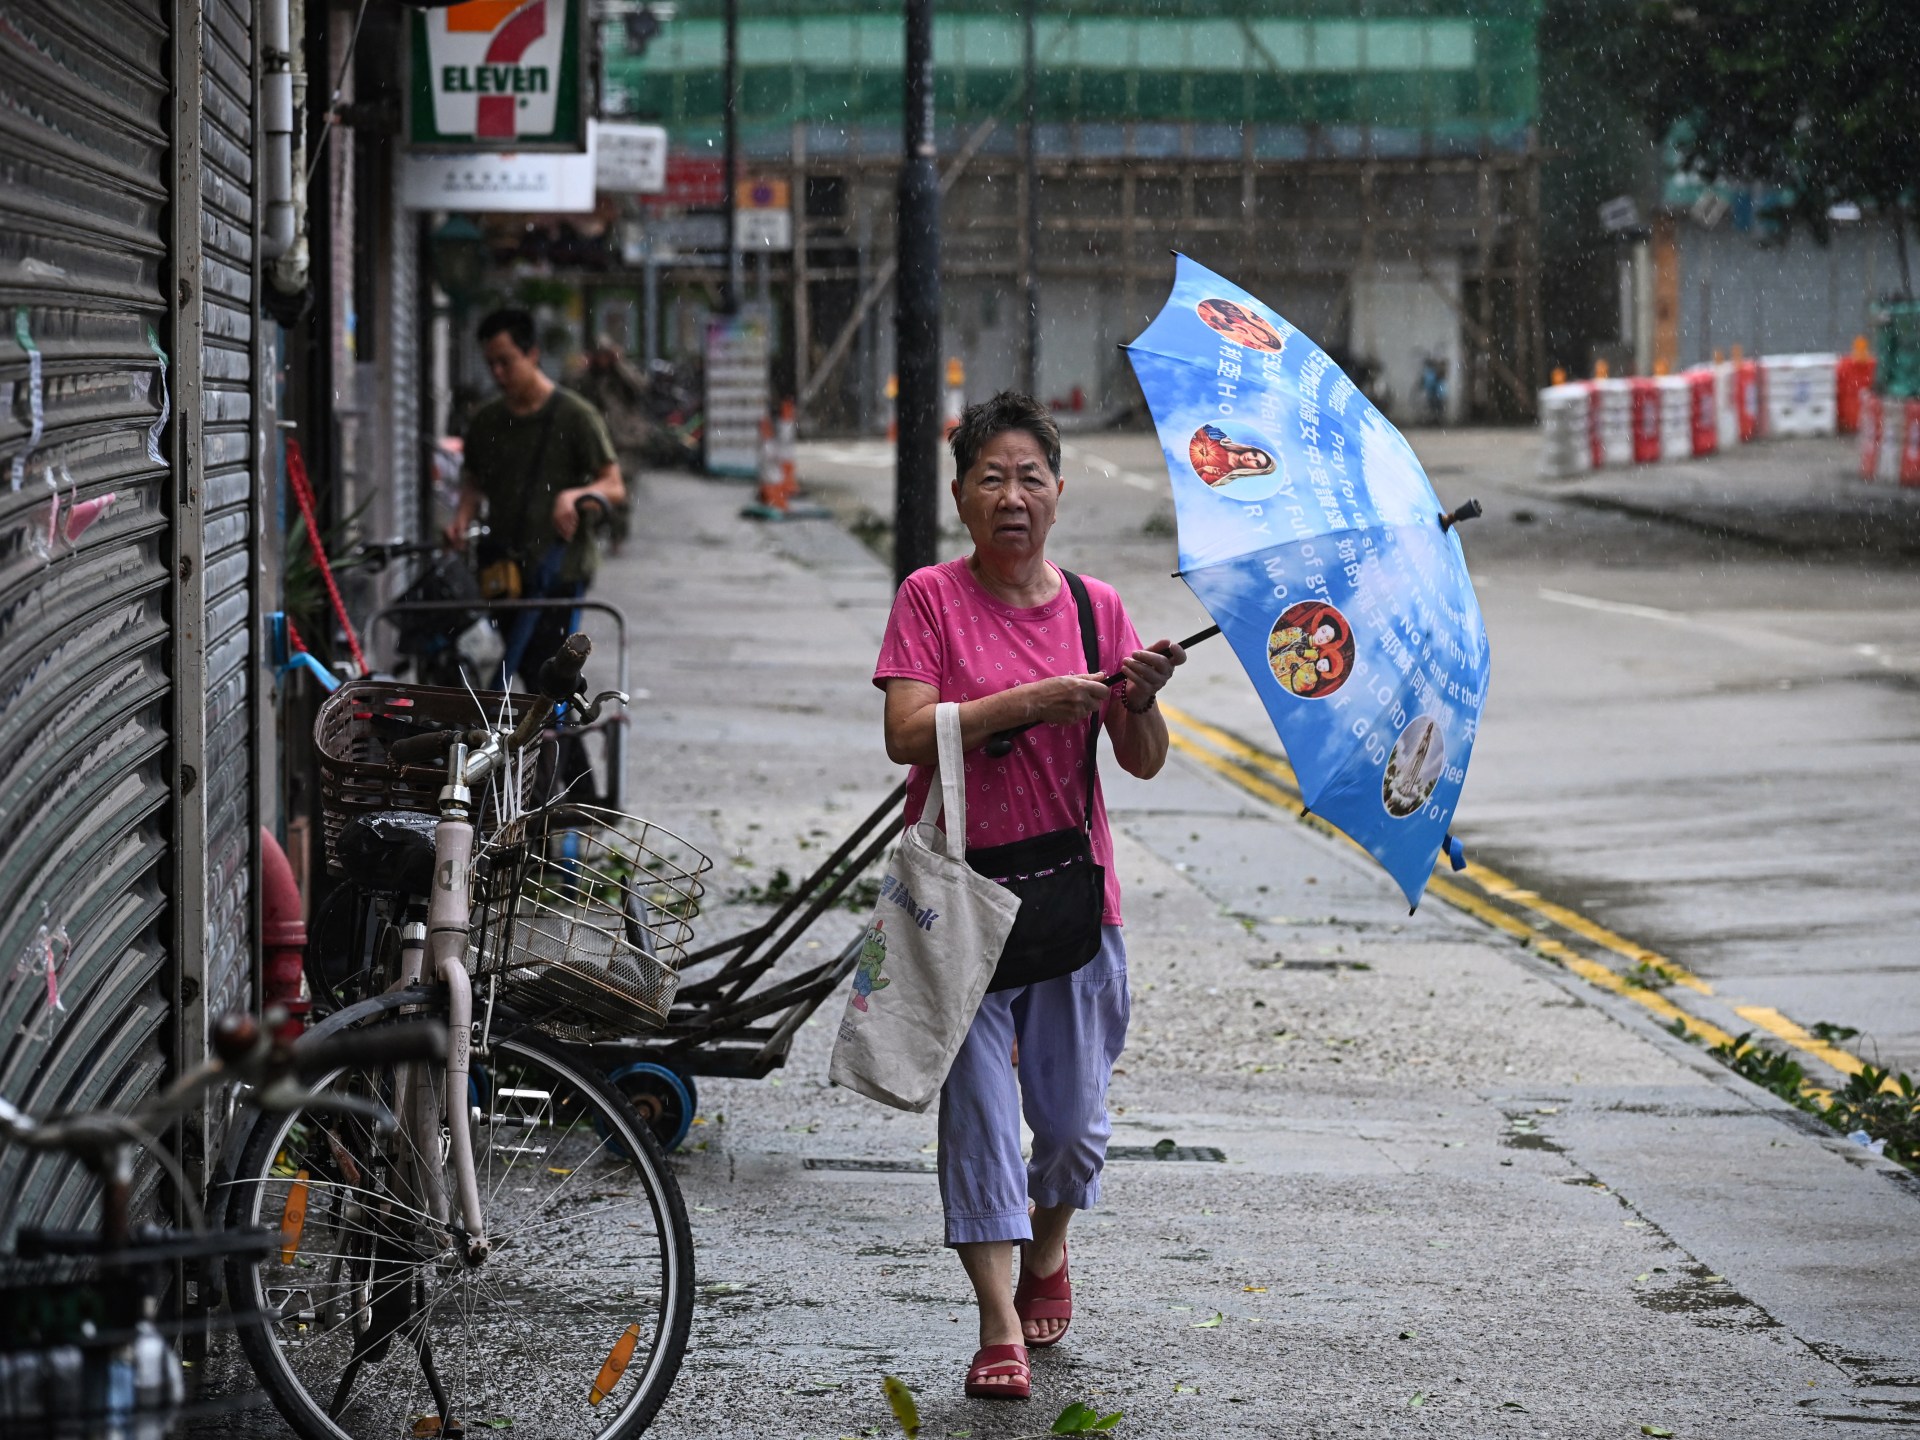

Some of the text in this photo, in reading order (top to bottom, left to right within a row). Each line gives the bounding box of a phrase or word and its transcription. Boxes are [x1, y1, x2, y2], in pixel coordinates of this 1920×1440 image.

[1330, 429, 1348, 477] Pray
[1339, 478, 1359, 508] for
[1352, 510, 1369, 532] us
[1361, 536, 1401, 616] sinners
[1429, 659, 1449, 690] and
[1447, 681, 1461, 701] at
[1449, 638, 1467, 671] thy
[1351, 717, 1387, 766] GOD
[1421, 797, 1449, 824] for
